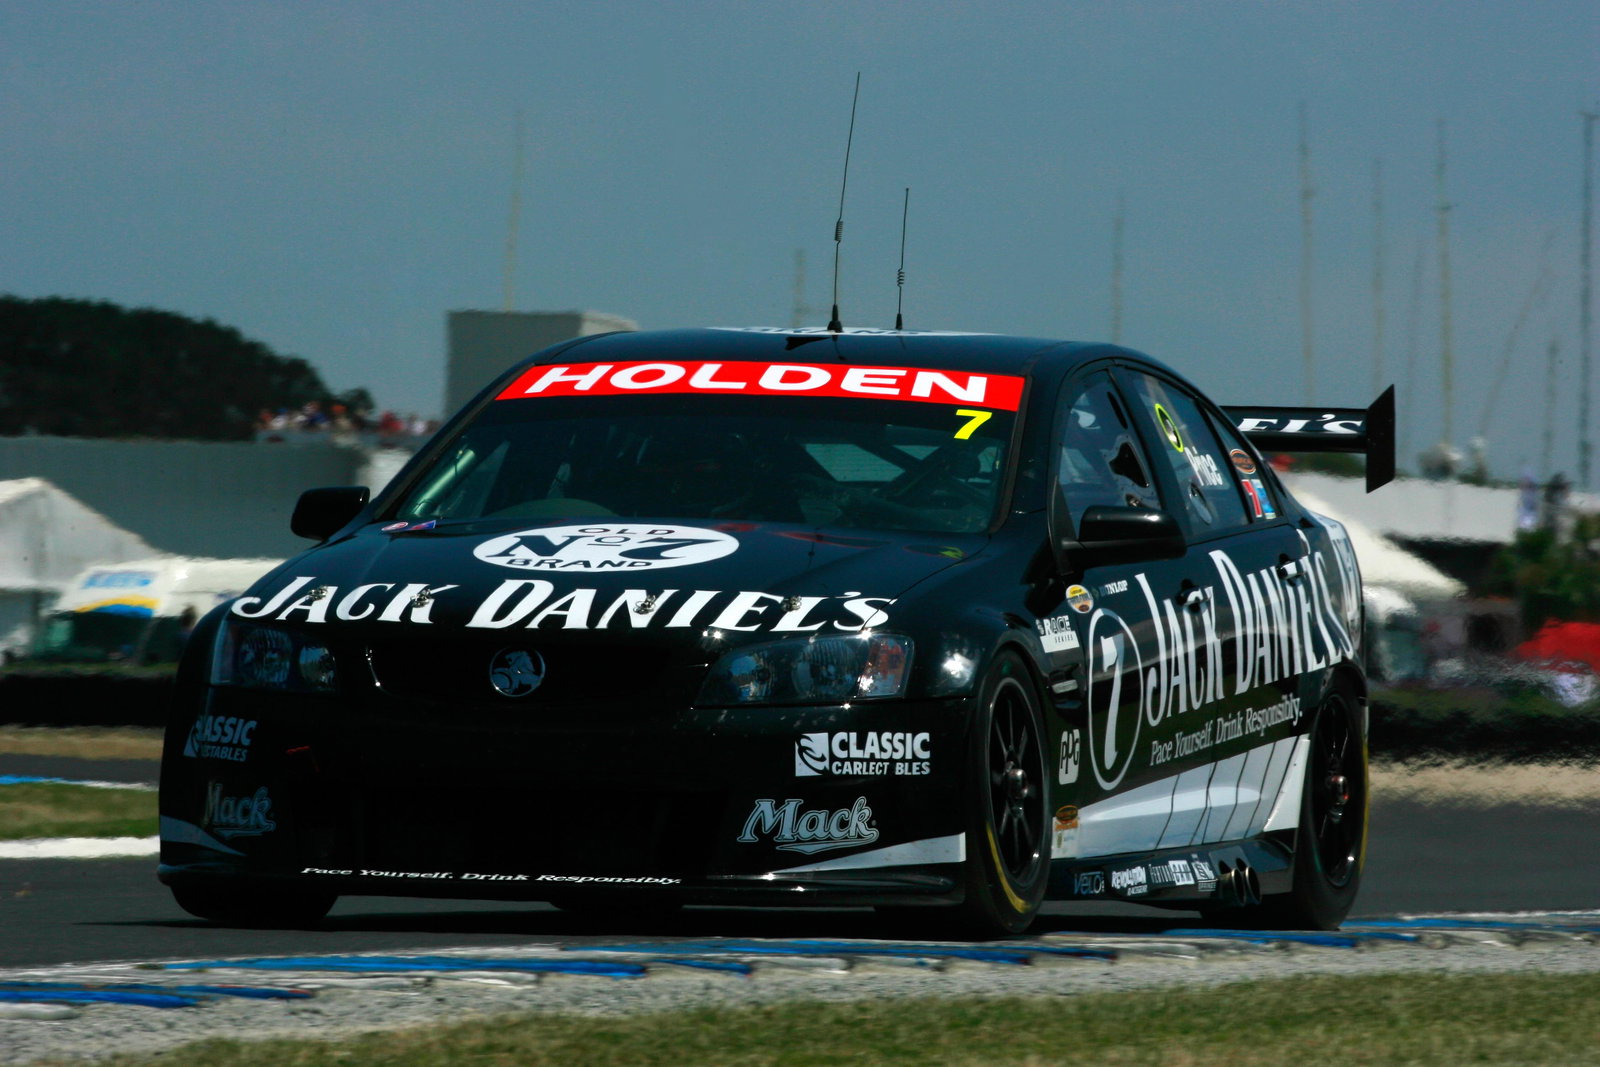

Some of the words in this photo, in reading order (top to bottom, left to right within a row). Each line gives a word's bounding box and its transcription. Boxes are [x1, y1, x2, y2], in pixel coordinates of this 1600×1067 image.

[523, 363, 988, 403] HOLDEN
[953, 409, 993, 440] 7
[577, 527, 676, 536] OLD
[505, 558, 653, 569] BRAND
[231, 575, 461, 624] JACK
[464, 579, 898, 632] DANIEL'S
[1043, 615, 1072, 636] RACE
[1135, 572, 1225, 727] JACK
[1100, 632, 1125, 770] 7
[831, 731, 931, 760] CLASSIC
[1150, 740, 1173, 767] Pace
[1216, 713, 1243, 745] Drink
[831, 761, 931, 776] CARLECTBLES
[737, 796, 879, 846] Mack
[301, 867, 353, 875] Pace
[359, 869, 454, 879] Yourself.
[460, 872, 530, 881] Drink
